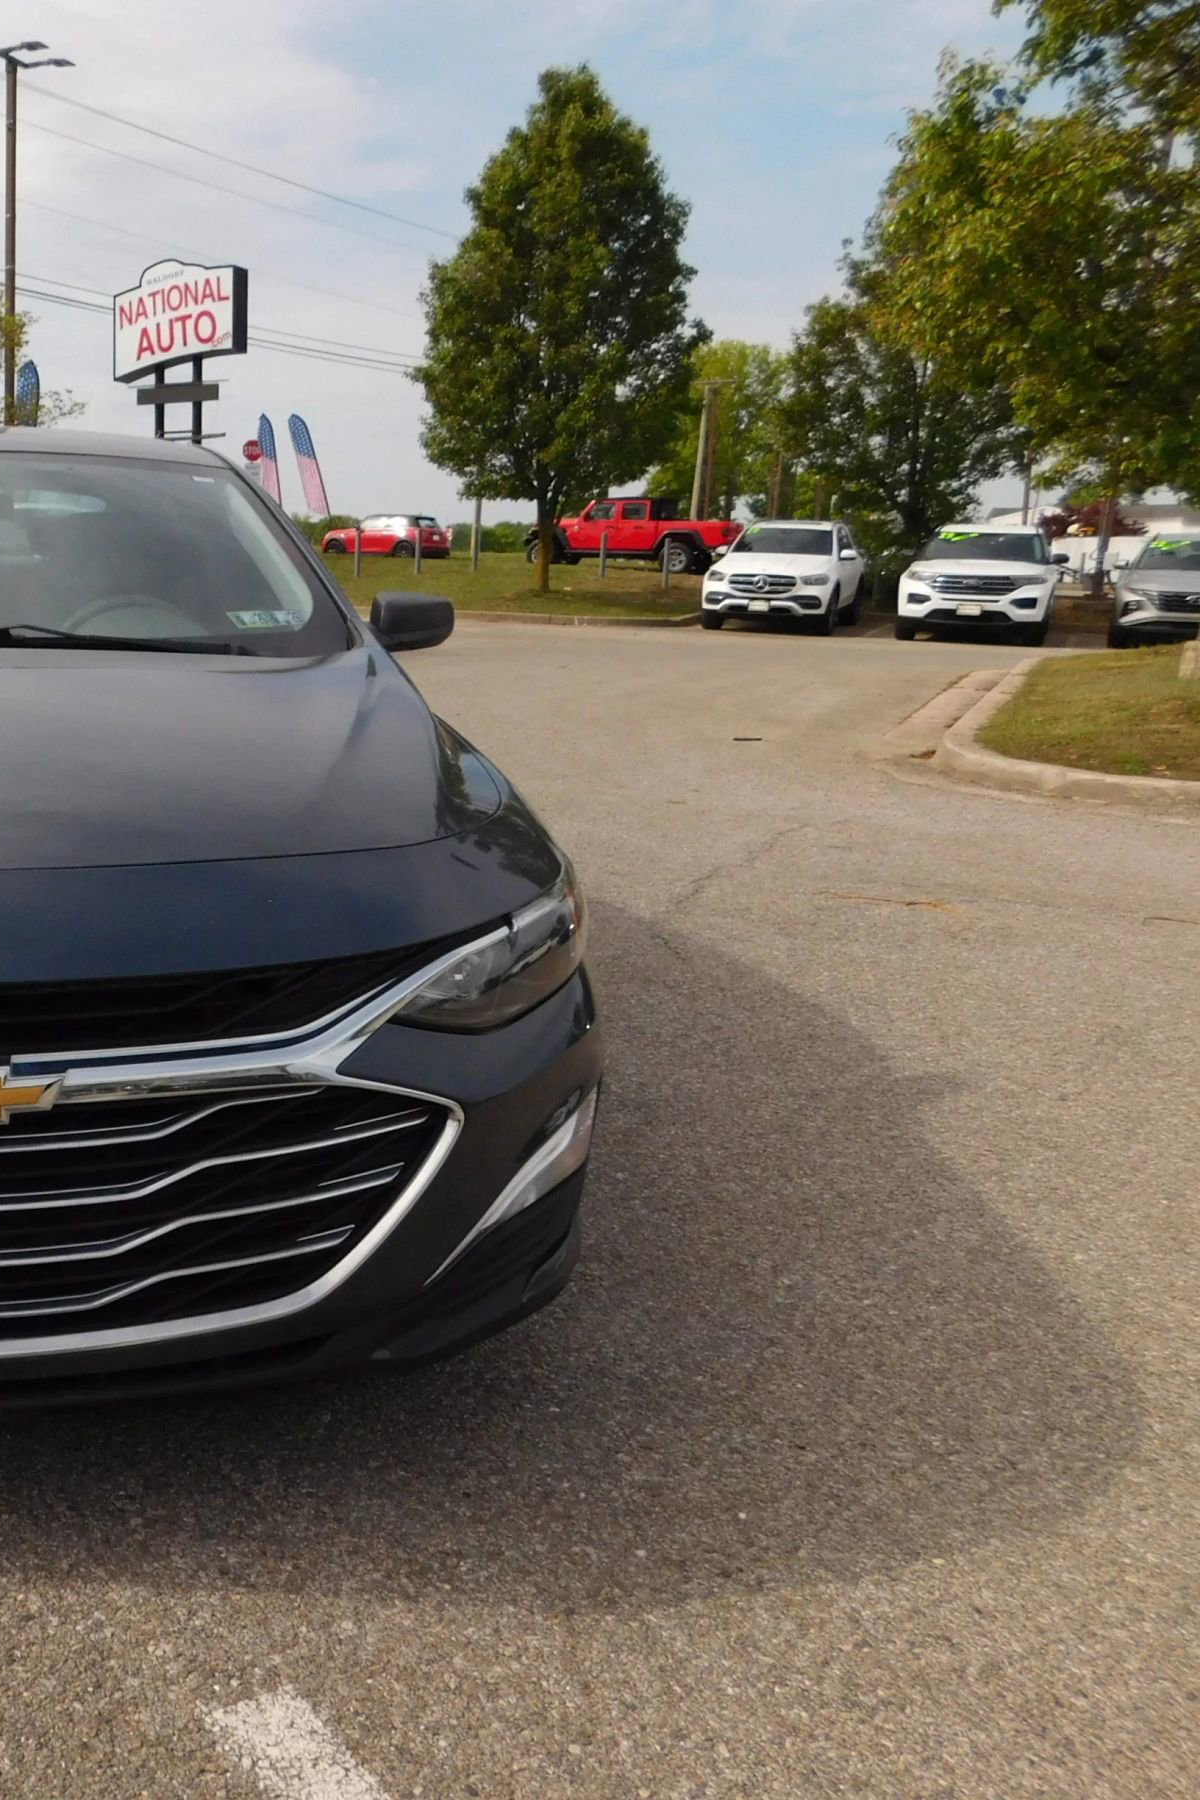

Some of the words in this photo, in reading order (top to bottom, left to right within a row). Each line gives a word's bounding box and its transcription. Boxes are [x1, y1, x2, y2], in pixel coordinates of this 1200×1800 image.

[119, 275, 230, 331] NATIONAL
[146, 269, 185, 286] WALDORF
[136, 310, 217, 362] AUTO
